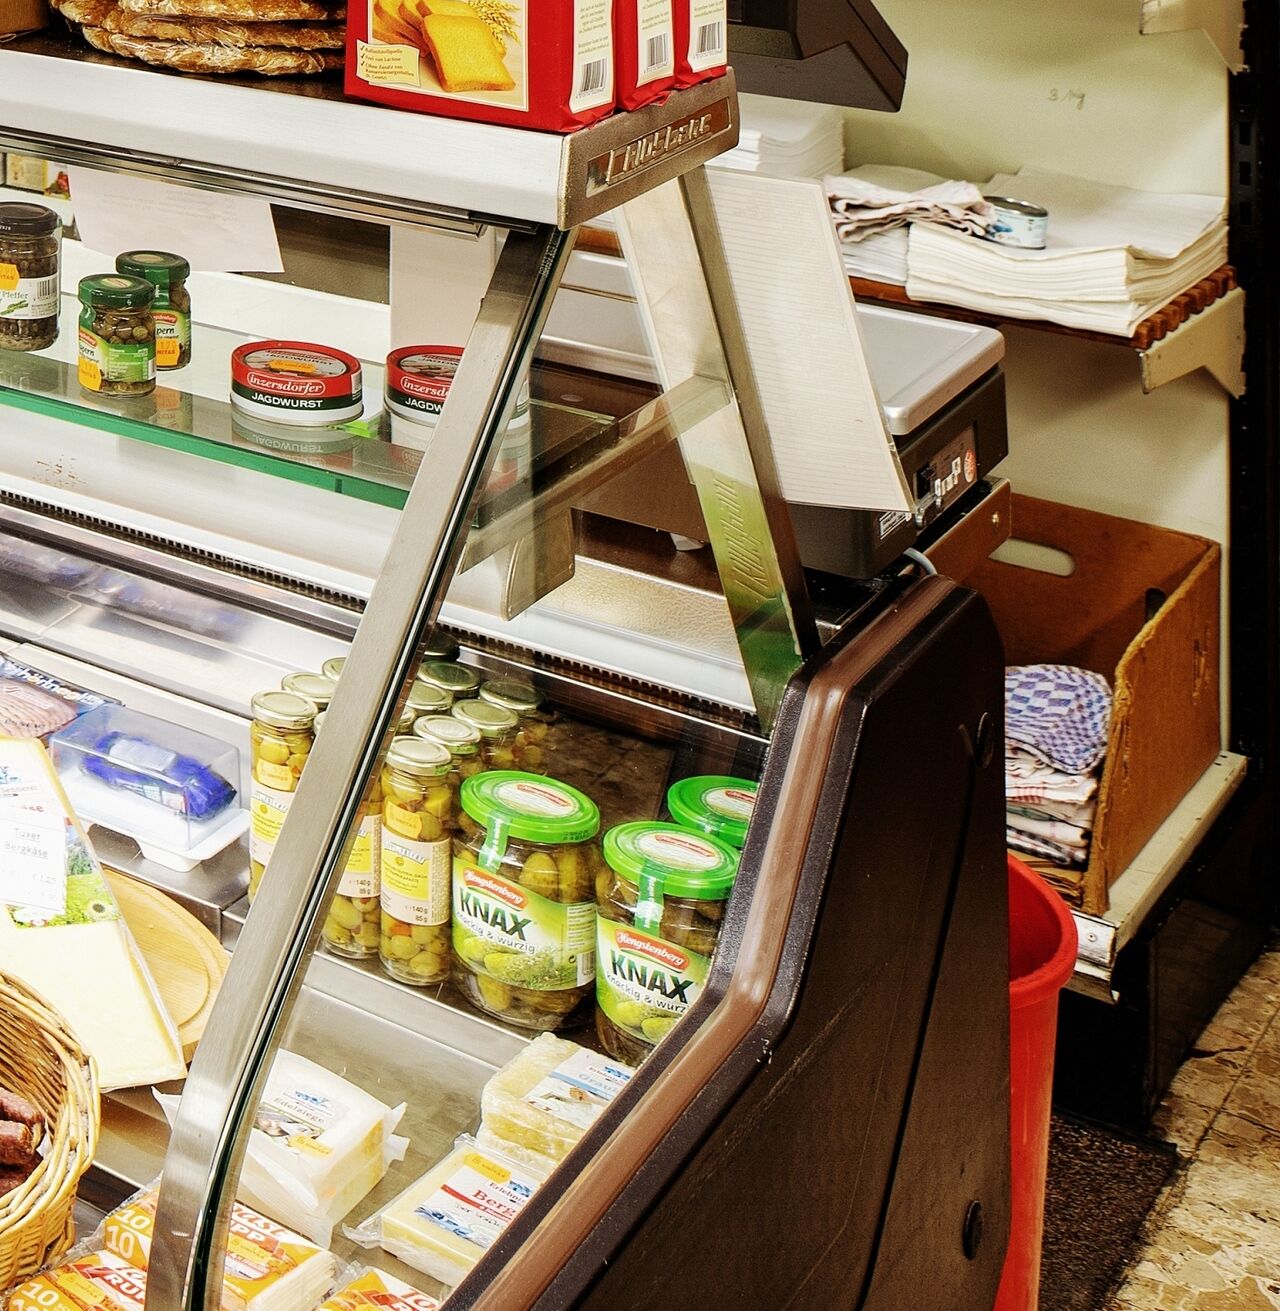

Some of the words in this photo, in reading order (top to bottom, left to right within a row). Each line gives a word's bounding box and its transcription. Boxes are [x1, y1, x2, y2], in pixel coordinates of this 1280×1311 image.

[1, 290, 30, 301] Pfeffer
[249, 372, 323, 395] inzersdorfer
[251, 391, 324, 409] JAGDWURST
[14, 827, 41, 841] Tuxer
[4, 840, 49, 859] Bergkäse
[464, 868, 525, 907] Hengstenberg
[458, 887, 533, 942] KNAX
[496, 932, 536, 956] würzig
[618, 930, 687, 967] Hengstenberg
[606, 973, 641, 1002] knackig
[609, 948, 694, 1005] KNAX
[273, 1096, 326, 1124] Edelziege
[106, 1224, 135, 1259] 10
